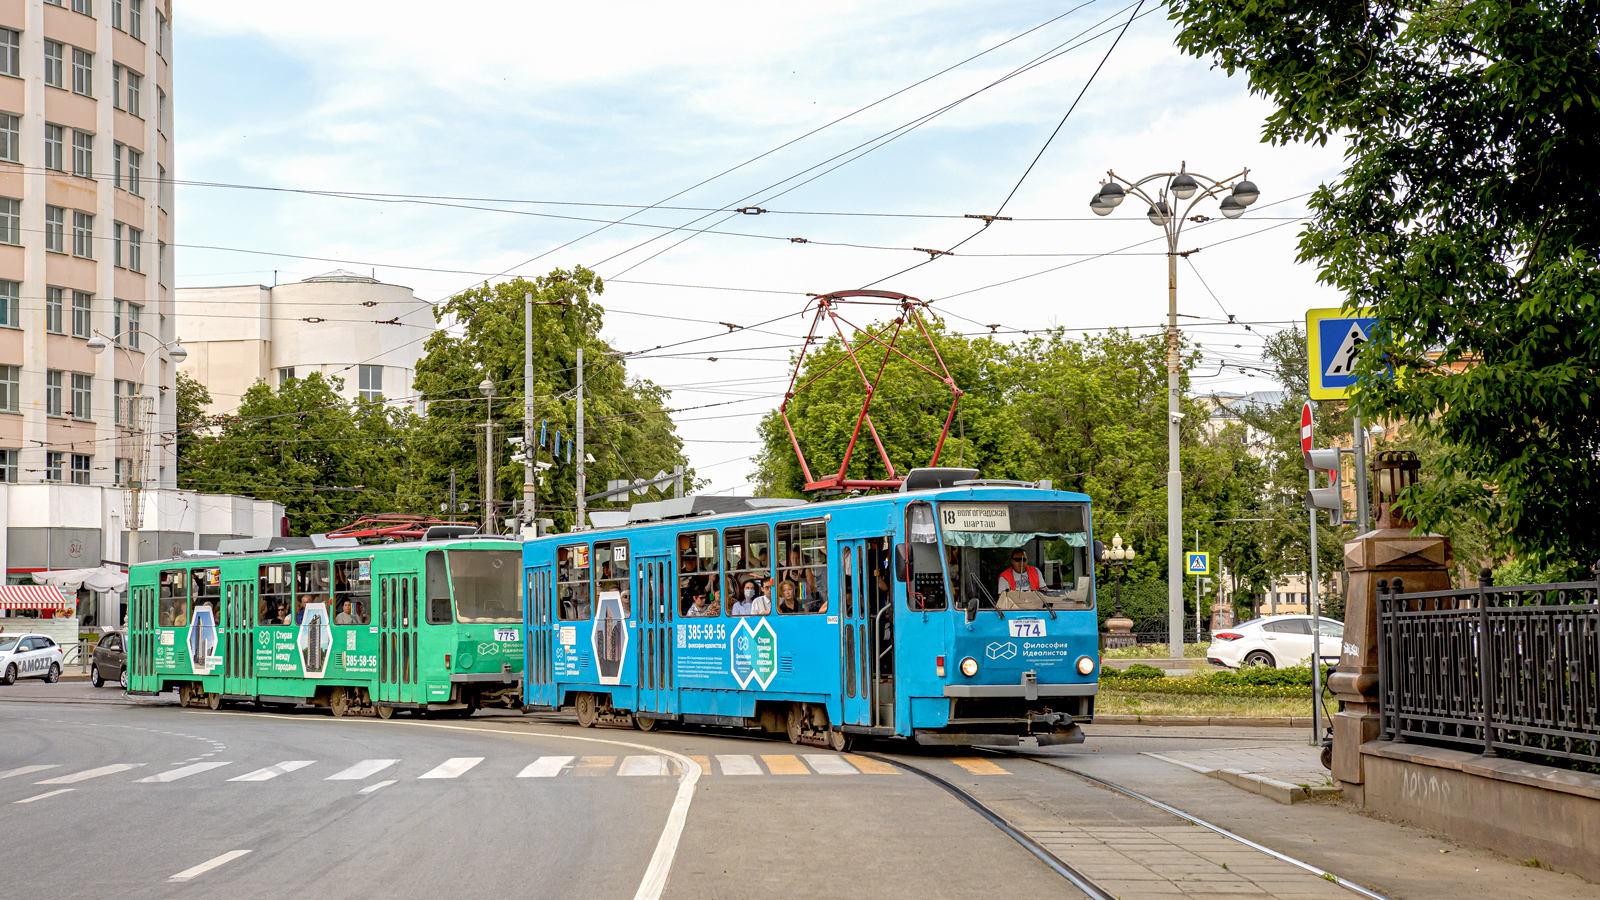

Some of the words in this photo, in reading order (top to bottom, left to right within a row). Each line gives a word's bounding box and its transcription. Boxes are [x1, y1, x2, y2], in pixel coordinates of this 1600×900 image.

[943, 510, 956, 524] 18
[616, 548, 625, 559] 774
[688, 624, 726, 640] 385-58-56
[1015, 624, 1040, 636] 774
[276, 631, 292, 641] Стирая
[498, 632, 515, 641] 775
[276, 653, 290, 662] между
[346, 655, 376, 666] 385-58-56
